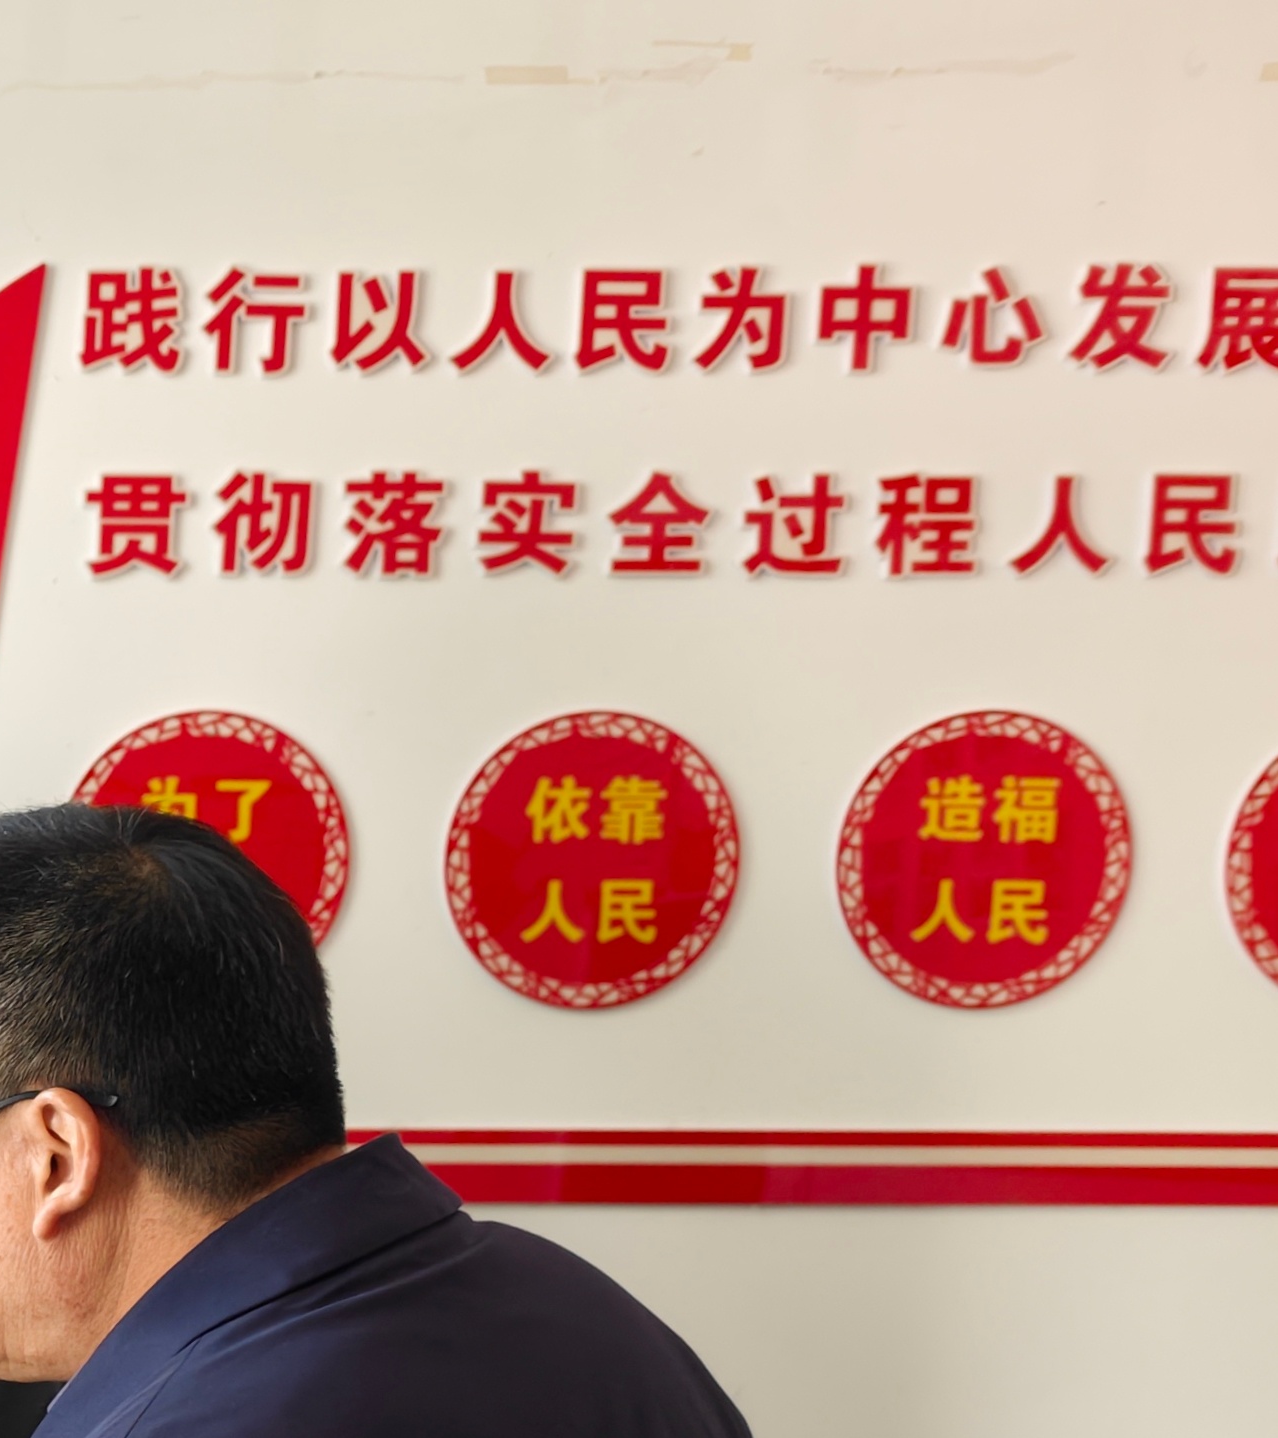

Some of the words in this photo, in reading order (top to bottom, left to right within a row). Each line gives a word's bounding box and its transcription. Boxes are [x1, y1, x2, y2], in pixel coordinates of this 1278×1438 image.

[82, 264, 1278, 374] 践行以人民为中心发展
[88, 472, 1236, 575] 贯彻落实全过程人民
[526, 776, 664, 843] 依靠
[920, 775, 1058, 843] 造福
[521, 880, 657, 944] 人民
[913, 879, 1048, 945] 人民
